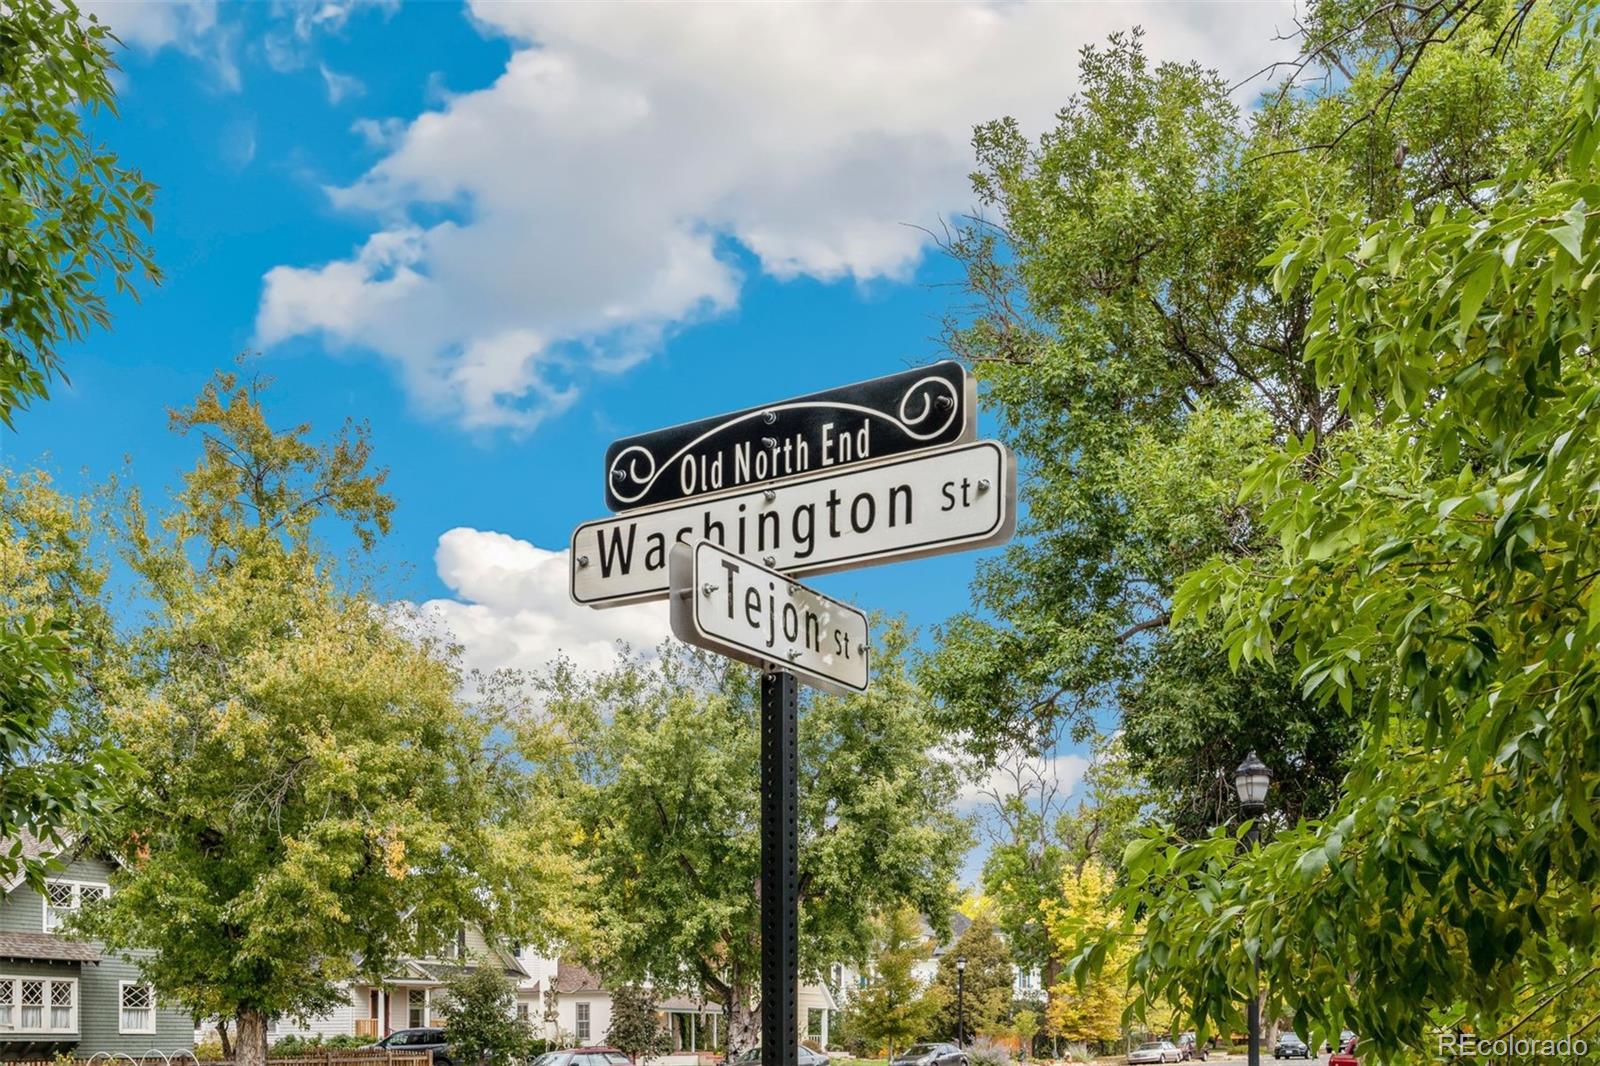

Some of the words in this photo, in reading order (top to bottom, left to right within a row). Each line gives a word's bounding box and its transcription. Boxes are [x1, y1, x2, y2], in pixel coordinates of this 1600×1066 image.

[680, 453, 722, 495] Old
[734, 434, 809, 483] North
[821, 419, 870, 465] End
[941, 477, 971, 512] St
[721, 559, 820, 653] Tejon
[833, 628, 850, 660] St
